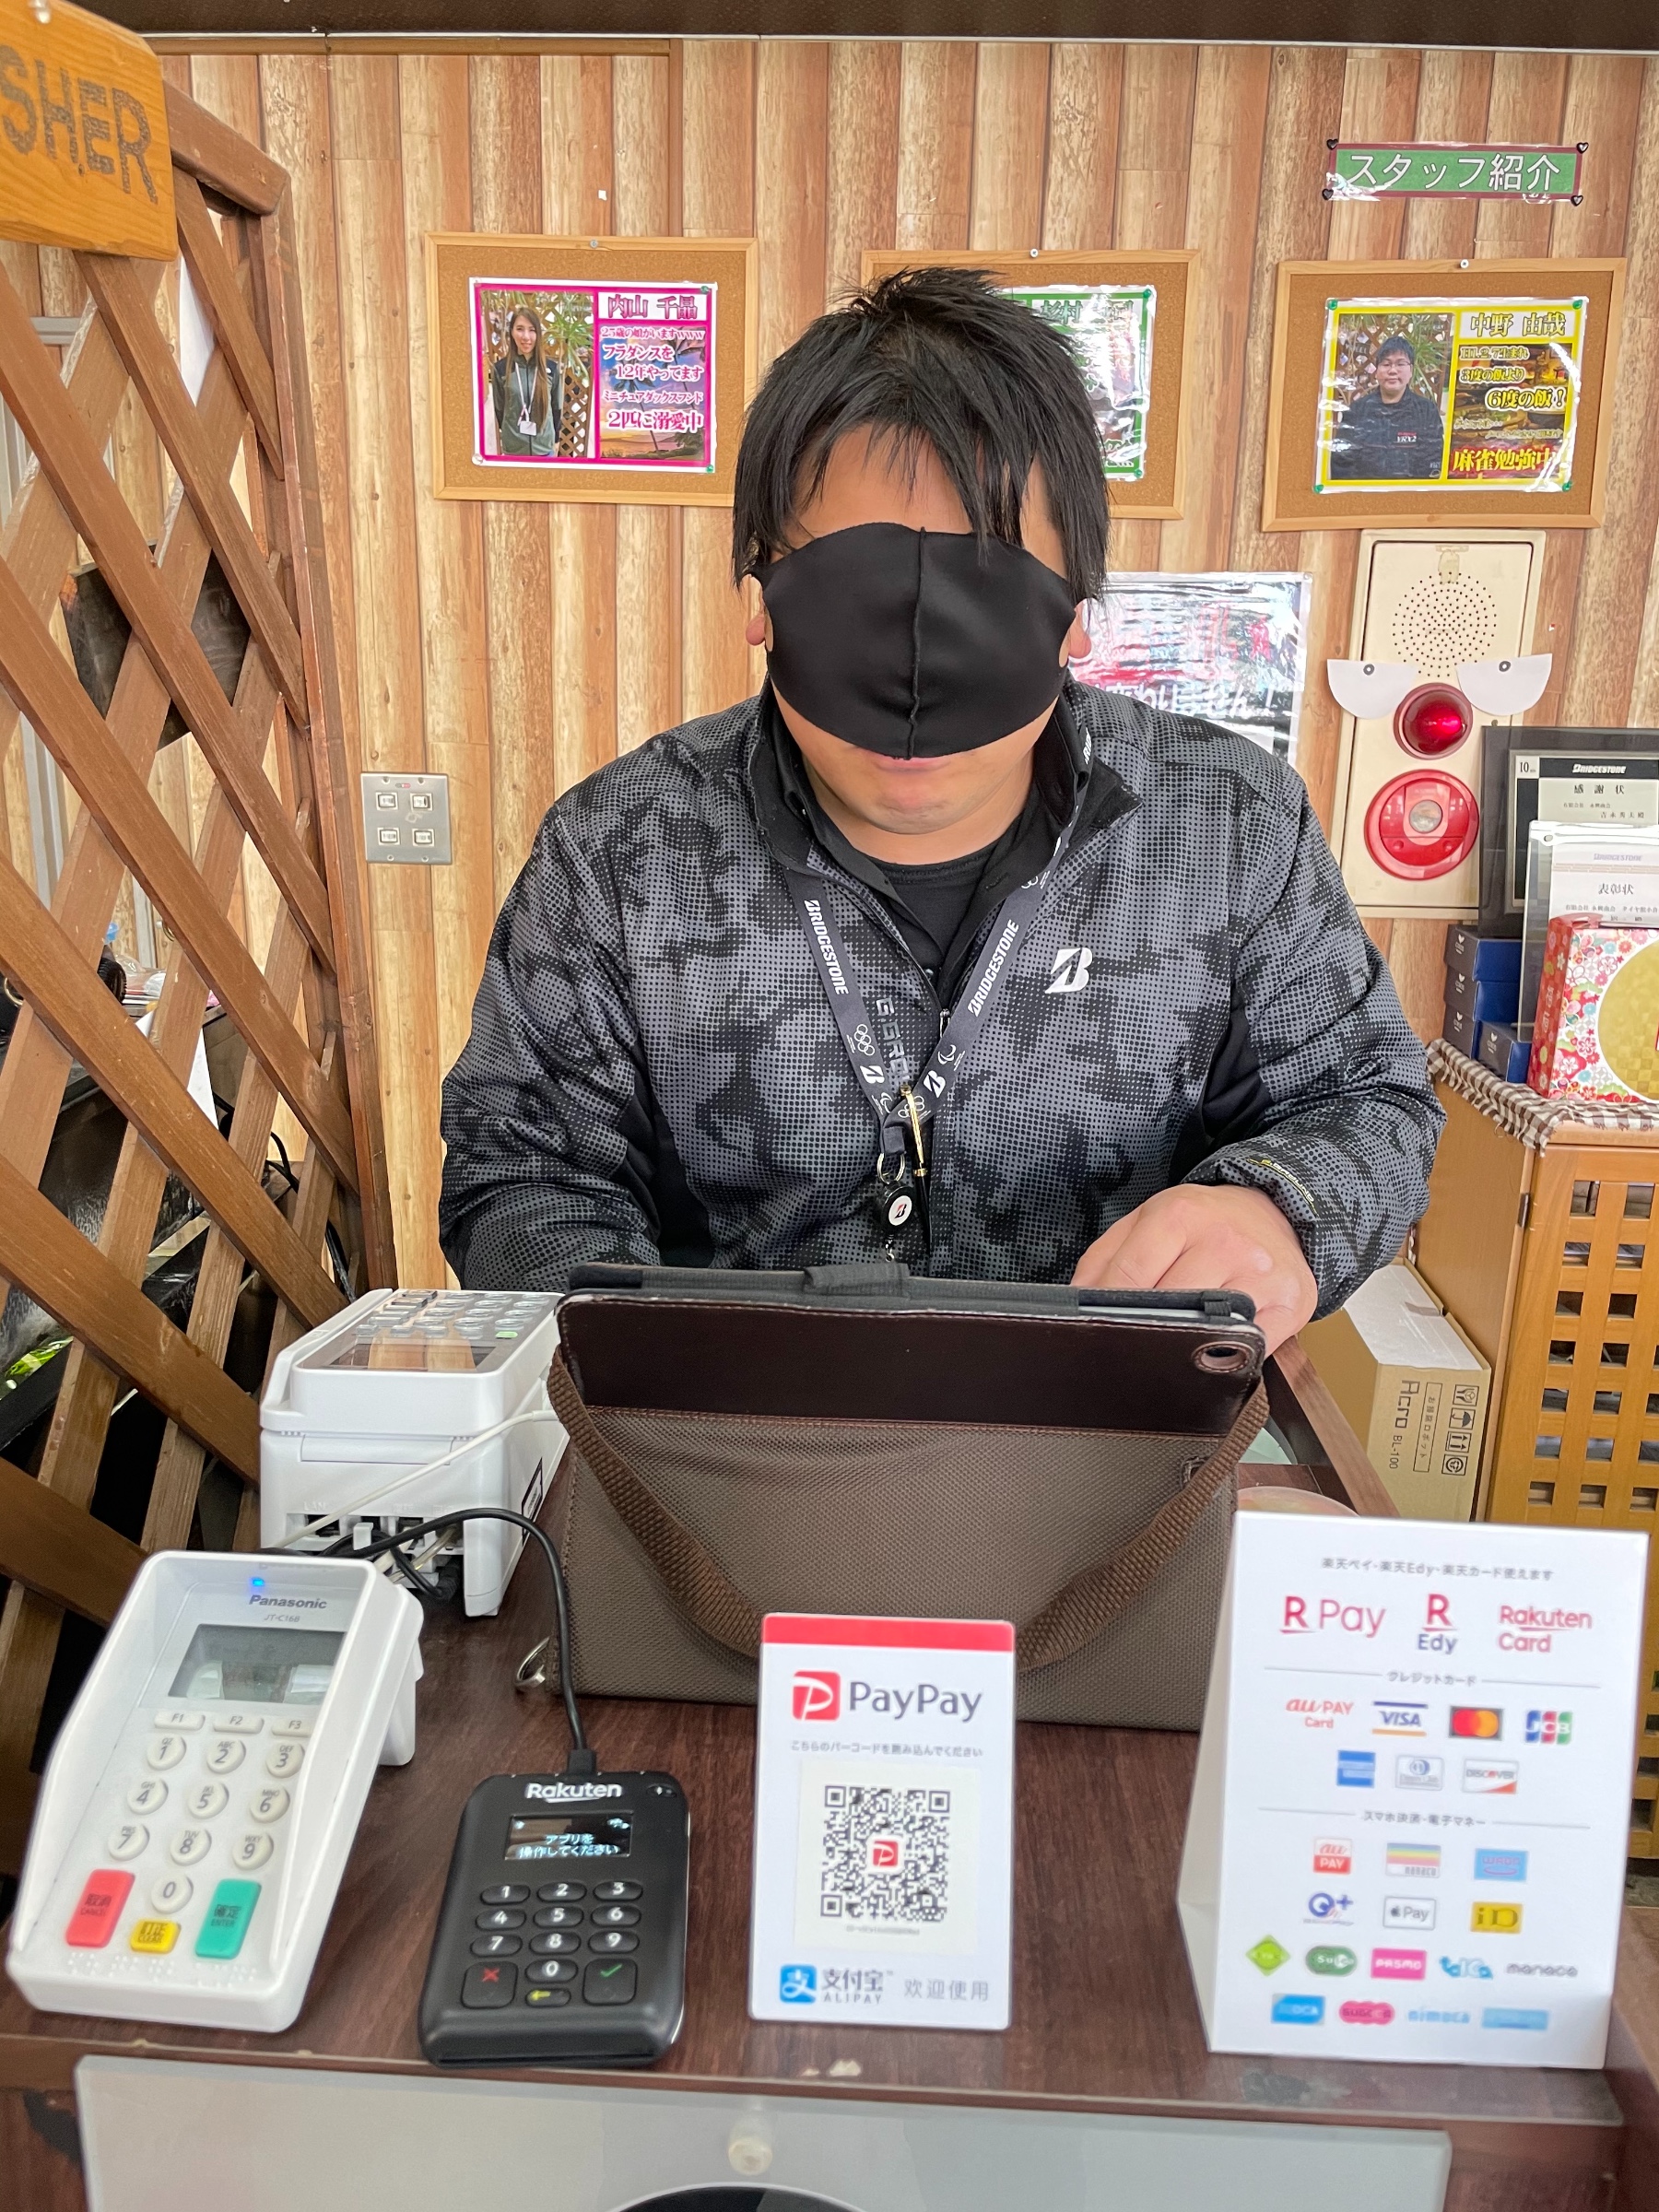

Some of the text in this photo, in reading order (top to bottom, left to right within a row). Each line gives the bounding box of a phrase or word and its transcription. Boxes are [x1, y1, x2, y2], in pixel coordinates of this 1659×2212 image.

[1347, 153, 1560, 191] スタッフ紹介
[608, 294, 698, 320] 内山 千晶
[1471, 312, 1566, 337] 中野 由哉
[604, 345, 674, 361] フラダンスを
[618, 365, 702, 380] 12年やってます
[604, 391, 703, 405] ミニチュアダックスフンド
[608, 411, 702, 431] 2匹に溺愛中
[1572, 763, 1627, 774] BRIDGESTONE
[1594, 853, 1643, 862] BRIDGESTONE
[804, 900, 850, 995] BRIDGESTONE
[968, 919, 1019, 1017] BRIDGESTONE
[1389, 1435, 1403, 1469] BL-100
[249, 1594, 327, 1609] Panasonic
[1320, 1599, 1386, 1639] Pay
[1500, 1605, 1593, 1630] Rakuten
[1418, 1633, 1458, 1655] Edy
[1499, 1631, 1552, 1654] Card
[1386, 1671, 1477, 1687] クレジットカード
[849, 1681, 982, 1723] PayPay
[1323, 1700, 1355, 1715] PAY
[171, 1713, 184, 1723] F1
[229, 1716, 242, 1725] F2
[288, 1720, 301, 1729] F3
[1305, 1717, 1335, 1729] Card
[1380, 1711, 1422, 1727] VISA
[159, 1746, 169, 1759] 1
[218, 1741, 235, 1749] ABC
[279, 1745, 295, 1753] DEF
[215, 1749, 229, 1764] 2
[276, 1753, 289, 1769] 3
[1465, 1769, 1516, 1780] DISCOVER
[136, 1790, 150, 1805] 4
[526, 1782, 622, 1800] Rakuten
[196, 1794, 212, 1809] 5
[260, 1797, 272, 1813] 6
[118, 1834, 133, 1849] 7
[183, 1830, 200, 1839] TUV
[244, 1835, 263, 1843] WXY
[546, 1833, 594, 1845] アプリを
[180, 1838, 193, 1854] 8
[242, 1843, 255, 1859] 9
[518, 1844, 620, 1858] 操作してください
[1320, 1857, 1345, 1869] PAY
[163, 1882, 176, 1899] 0
[501, 1885, 511, 1899] 1
[556, 1883, 569, 1897] 2
[612, 1881, 625, 1895] 3
[494, 1911, 508, 1924] 4
[553, 1907, 566, 1923] 5
[609, 1906, 623, 1921] 6
[1403, 1906, 1430, 1922] Pay
[1477, 1907, 1519, 1928] iD
[490, 1935, 504, 1951] 7
[548, 1933, 562, 1949] 8
[608, 1932, 622, 1947] 9
[546, 1959, 559, 1977] 0
[822, 1969, 989, 2002] 支付宝 欢迎使用
[824, 1993, 882, 2005] ALIPAY
